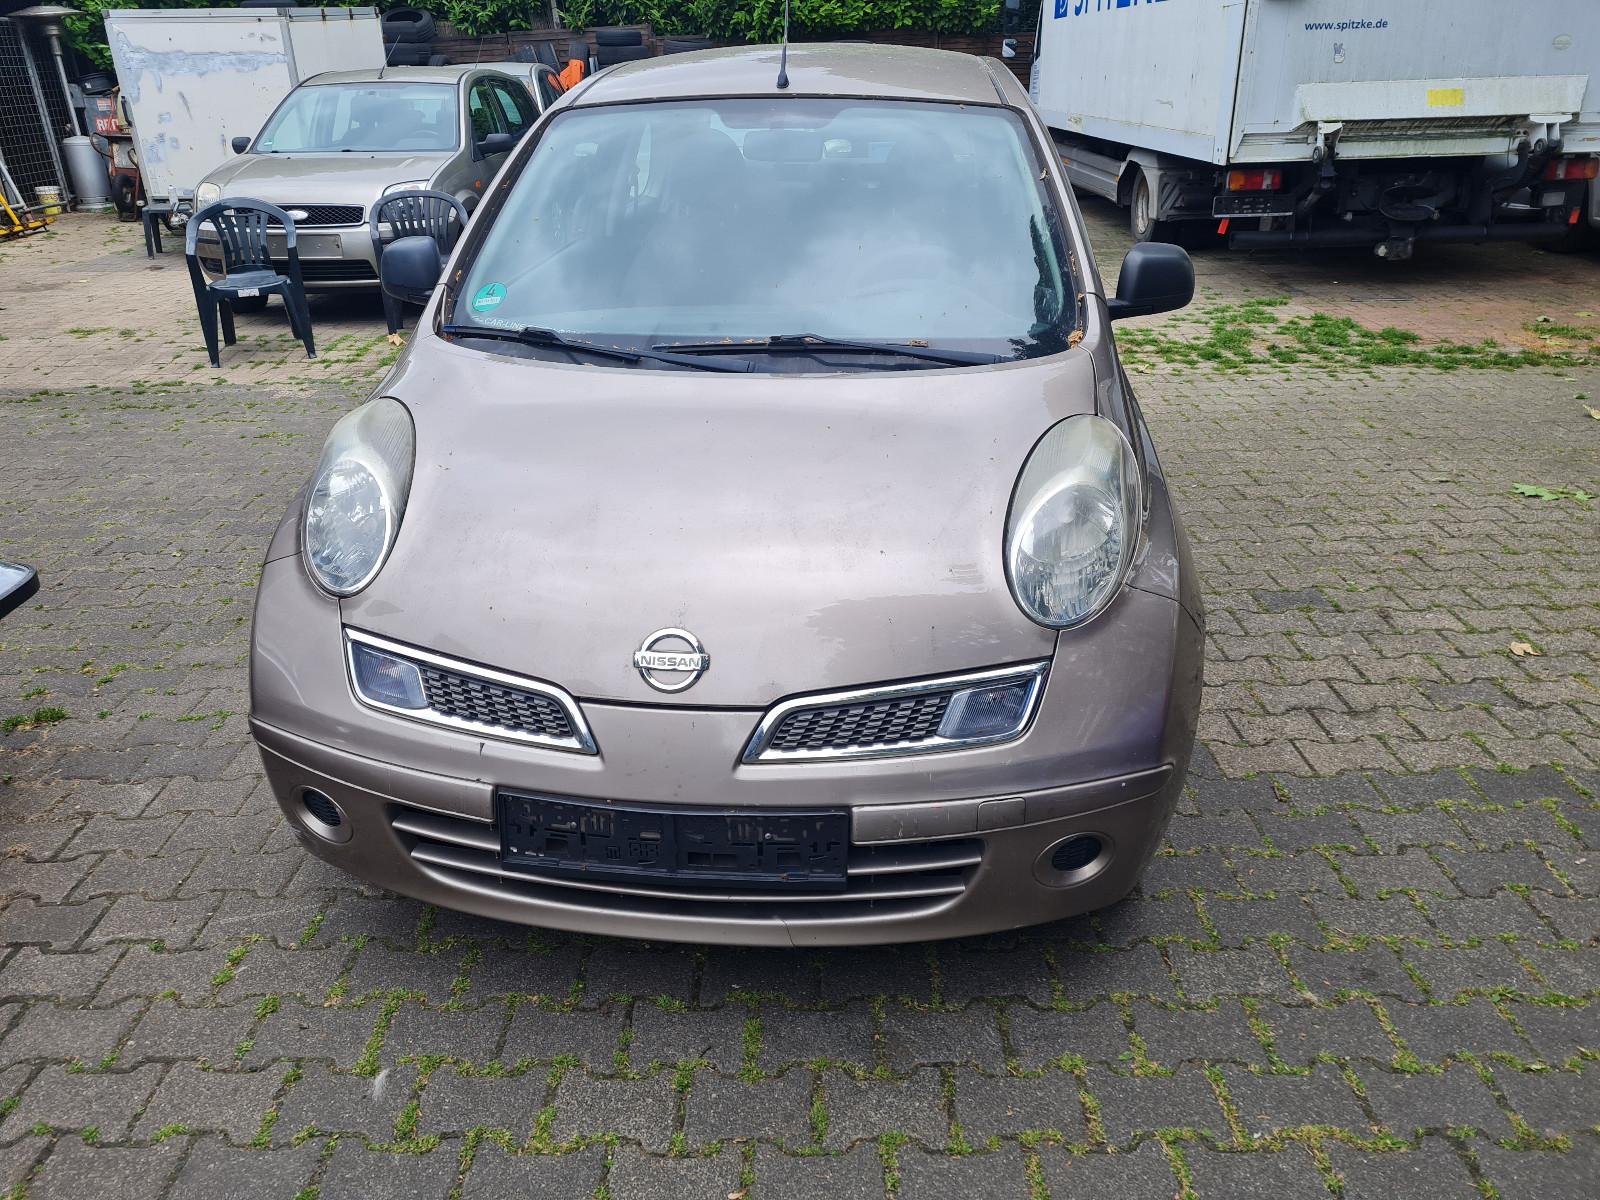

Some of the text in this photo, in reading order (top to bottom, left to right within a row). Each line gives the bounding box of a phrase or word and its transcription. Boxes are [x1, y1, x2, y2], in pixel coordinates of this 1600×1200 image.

[1305, 19, 1388, 31] www.spitzke.de
[486, 283, 497, 297] 4
[640, 655, 701, 667] NISSAN
